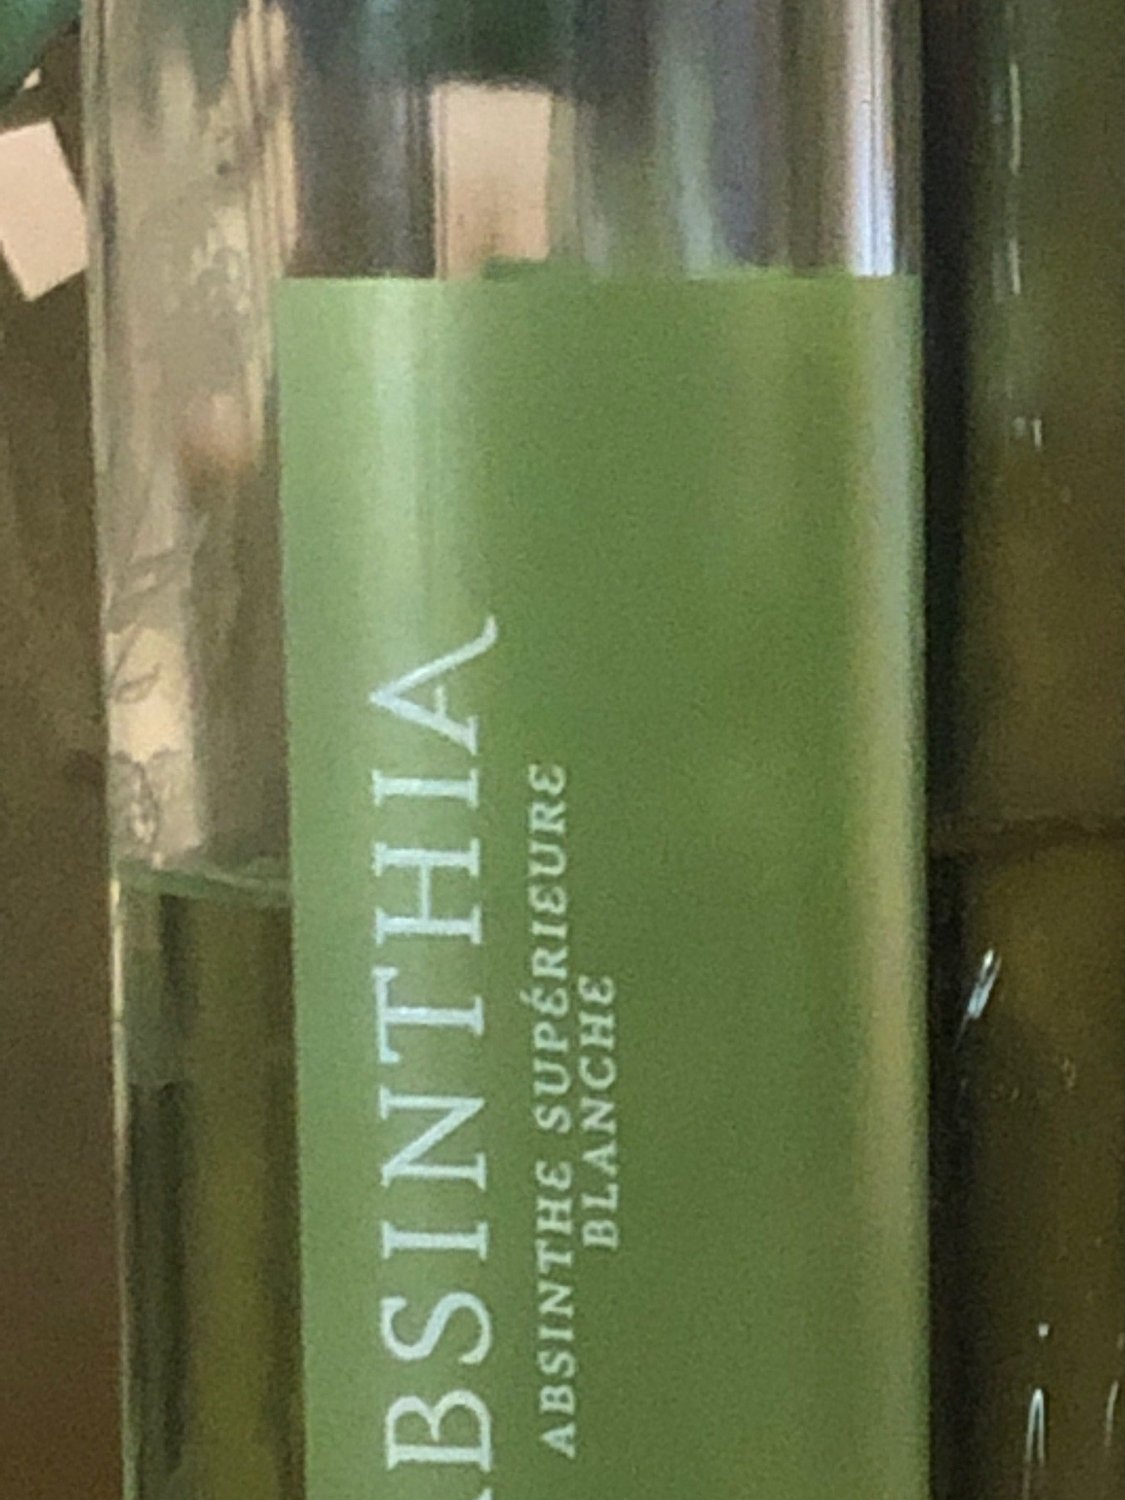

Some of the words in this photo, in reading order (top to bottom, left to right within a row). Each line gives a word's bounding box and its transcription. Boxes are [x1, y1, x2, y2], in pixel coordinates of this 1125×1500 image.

[520, 762, 573, 1134] SUPÉRIEURE
[578, 974, 620, 1250] BLANCHE
[536, 1158, 576, 1459] ABSINTHE
